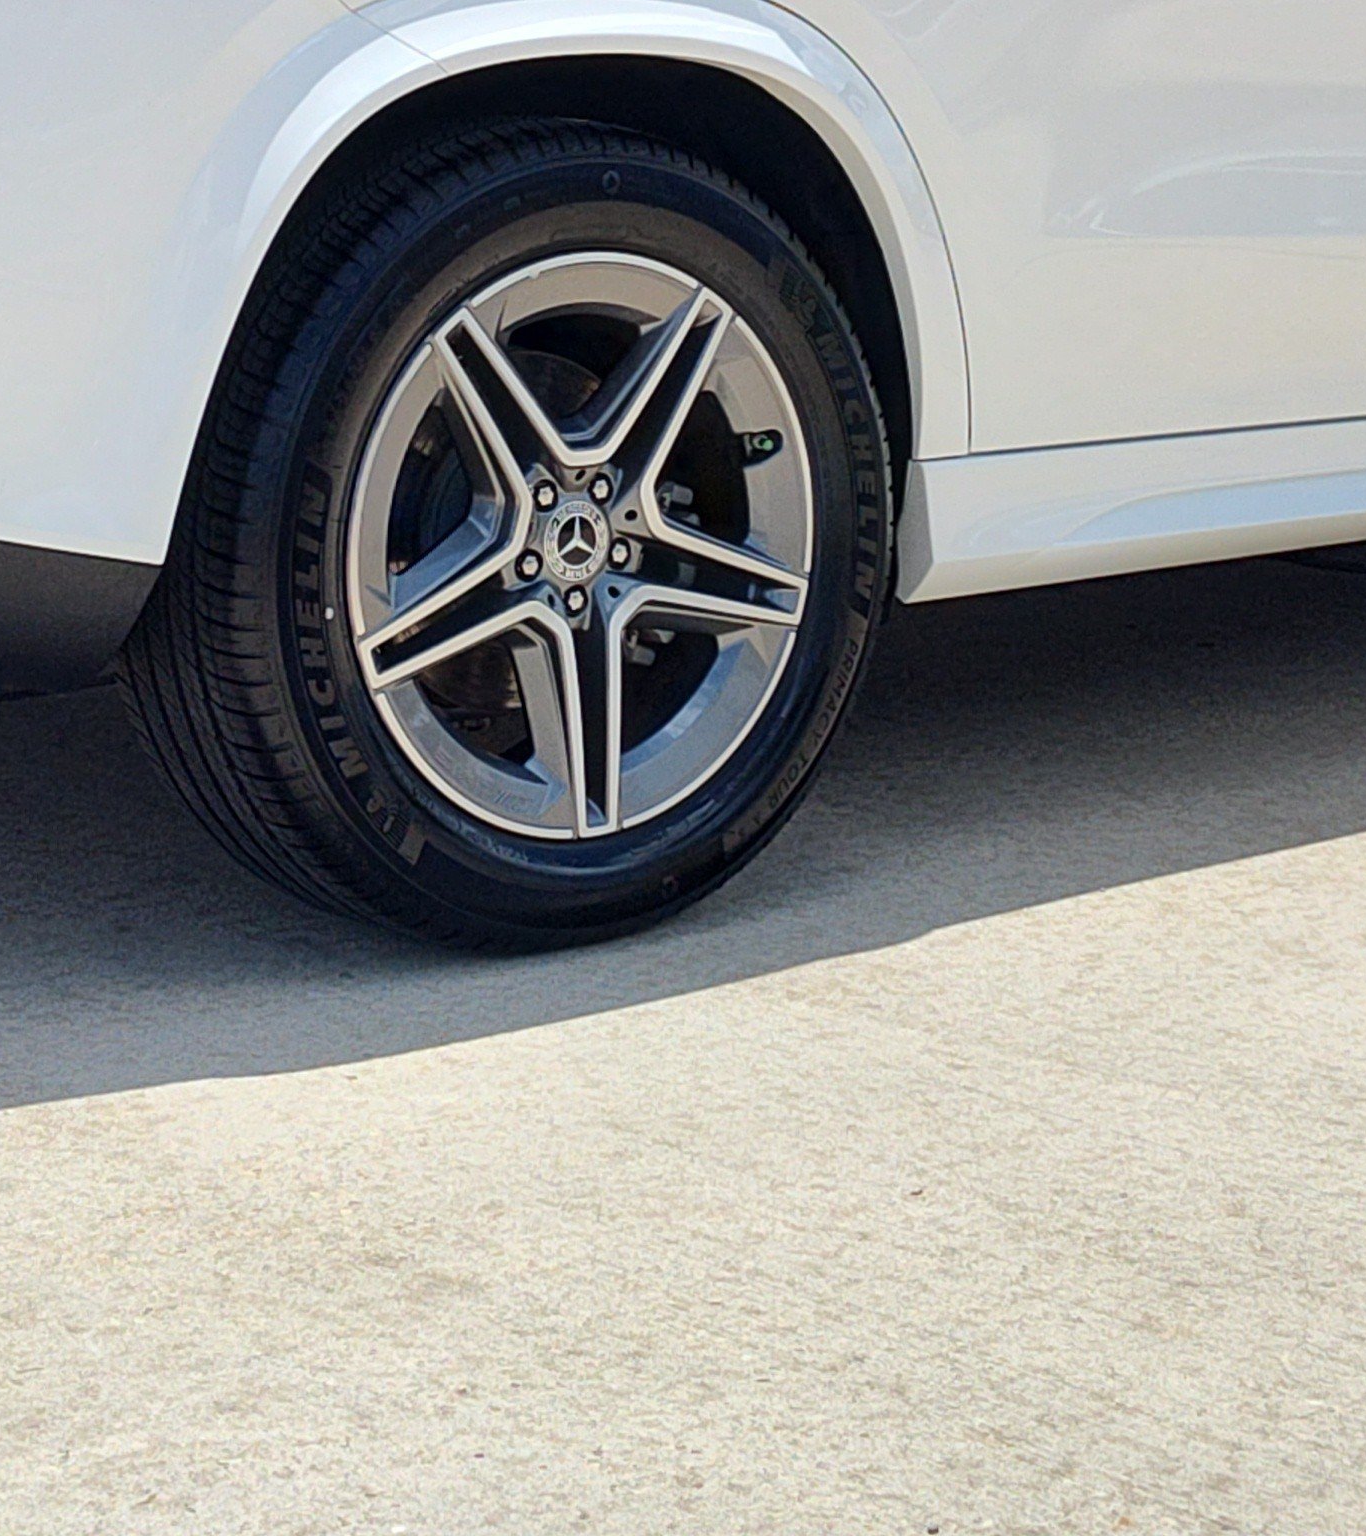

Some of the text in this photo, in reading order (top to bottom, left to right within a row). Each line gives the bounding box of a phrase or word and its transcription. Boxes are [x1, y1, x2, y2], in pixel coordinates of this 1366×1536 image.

[815, 331, 878, 603] MICHELIN
[294, 480, 369, 779] MICHELIN
[767, 637, 859, 808] PRIMACY TOUR
